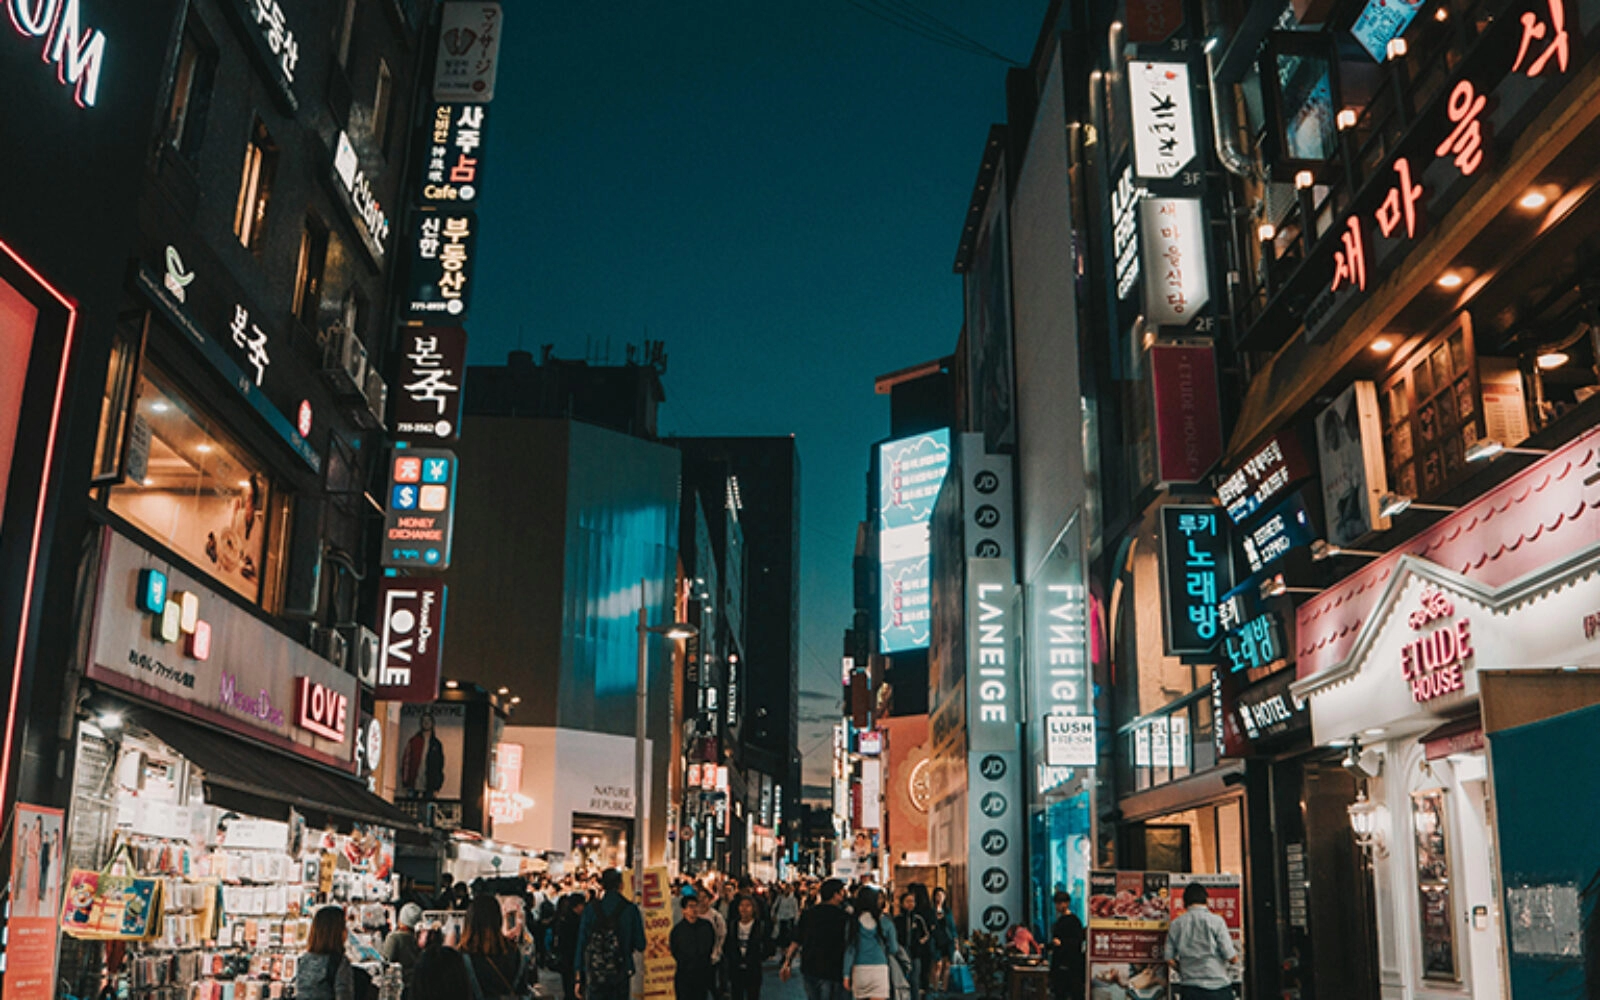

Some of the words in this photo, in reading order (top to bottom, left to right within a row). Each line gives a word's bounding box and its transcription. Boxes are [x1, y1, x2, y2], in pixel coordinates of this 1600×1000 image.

[475, 7, 497, 77] マッサージ
[1172, 39, 1189, 51] 3F
[424, 185, 457, 200] Cafe
[1183, 172, 1201, 186] 3F
[419, 217, 440, 259] 신한
[438, 217, 470, 299] 부동산
[1159, 202, 1187, 314] 새마을식당
[1195, 318, 1214, 331] 2F
[229, 303, 270, 387] 본죽
[403, 335, 459, 415] 본죽
[388, 528, 443, 541] EXCHANGE
[398, 517, 435, 529] MONEY
[1178, 514, 1218, 537] 루키
[1185, 539, 1220, 639] 노래방
[379, 590, 417, 686] LOVE
[978, 583, 1007, 723] LANEIGE
[1226, 614, 1274, 673] 노래방
[1400, 618, 1474, 681] ETUDE
[1411, 664, 1464, 703] HOUSE
[301, 676, 348, 743] LOVE
[1051, 722, 1092, 734] LUSH
[1252, 695, 1293, 728] HOTEL
[588, 798, 632, 812] REPUBLIC
[594, 784, 631, 797] NATURE
